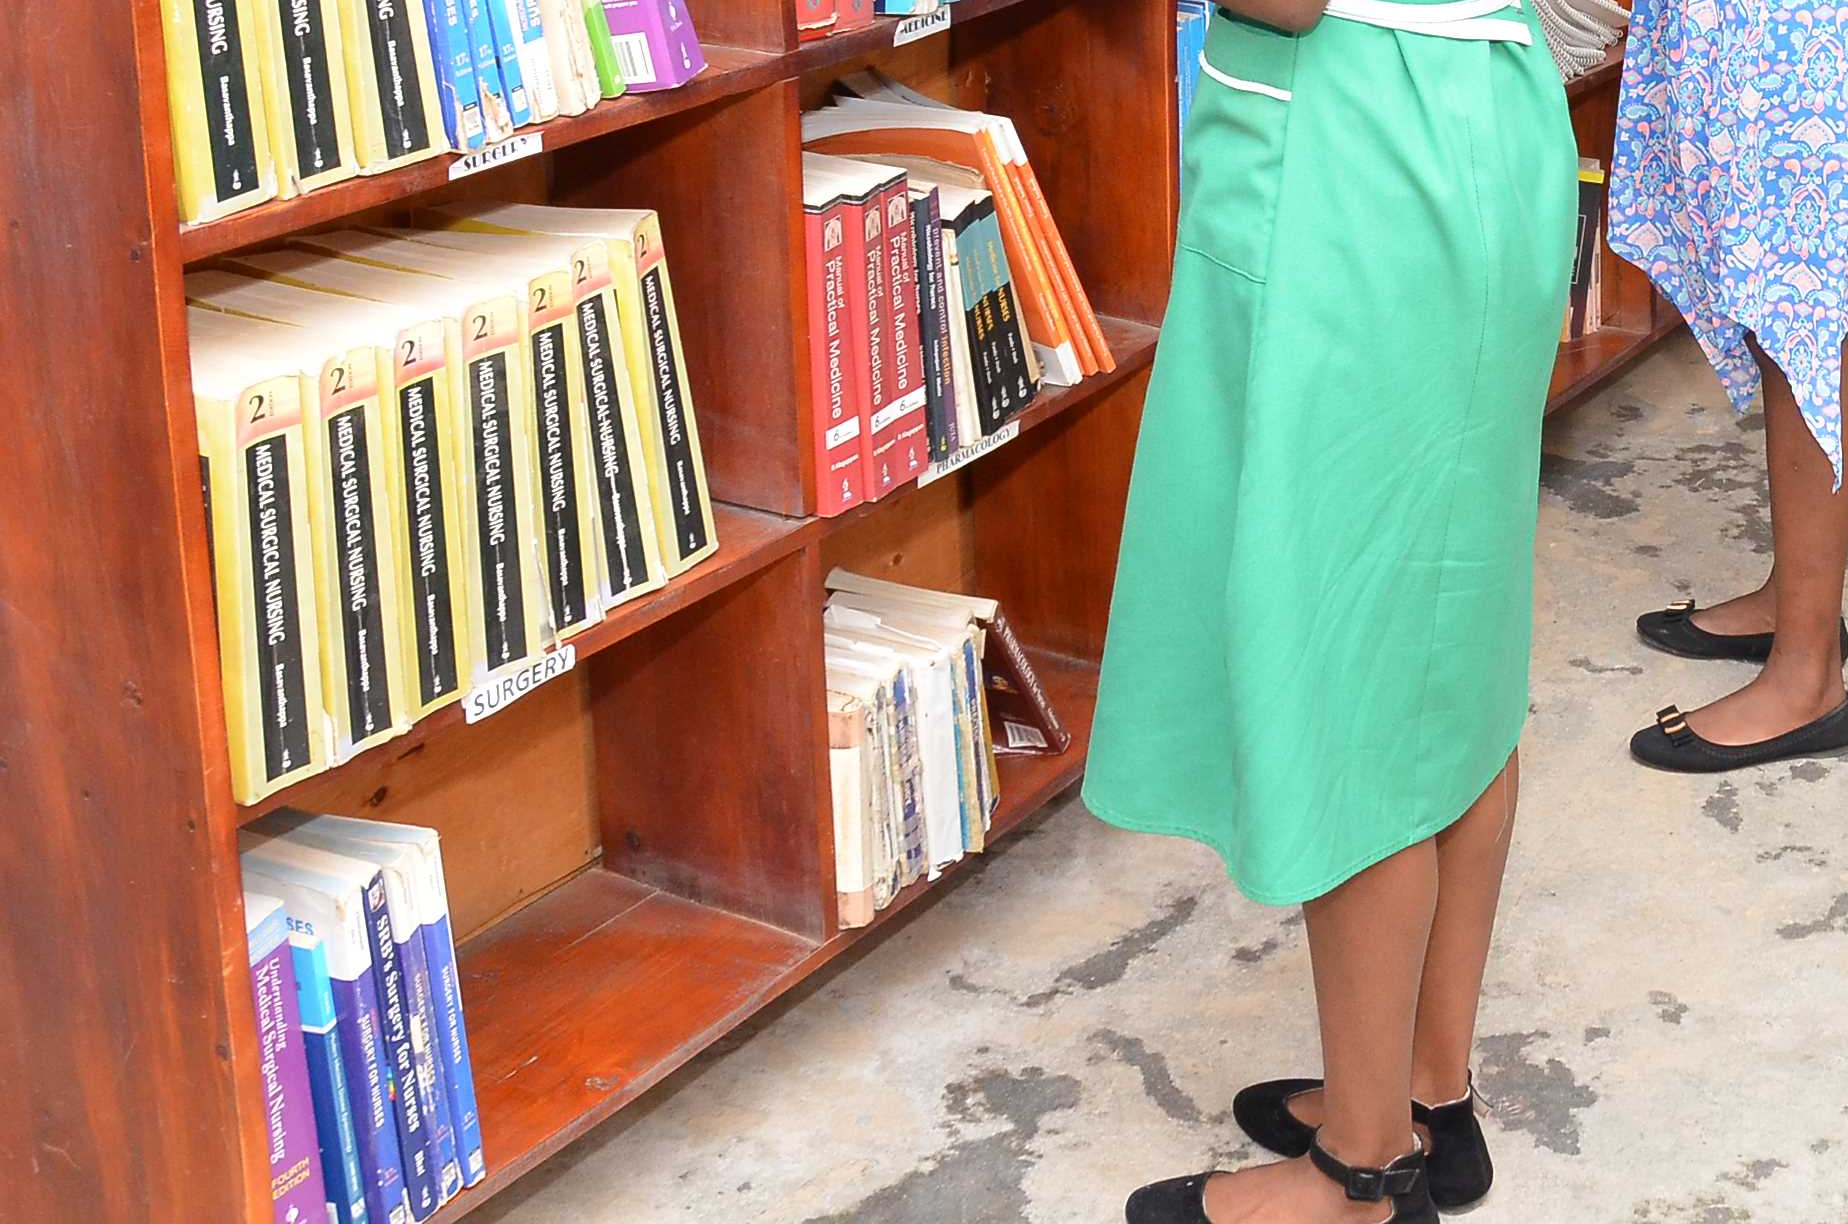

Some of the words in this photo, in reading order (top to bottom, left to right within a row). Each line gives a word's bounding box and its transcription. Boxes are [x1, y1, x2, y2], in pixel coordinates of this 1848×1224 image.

[575, 259, 587, 283] 2
[637, 234, 646, 258] 2
[873, 245, 883, 284] Manual
[888, 236, 904, 310] Practical
[898, 231, 908, 269] Manual
[533, 288, 547, 312] 2
[643, 274, 662, 328] MEDICAL
[823, 260, 838, 336] Practical
[833, 256, 844, 295] Manual
[836, 297, 845, 308] of
[864, 250, 879, 324] Practical
[875, 286, 883, 296] of
[901, 271, 909, 281] of
[401, 340, 416, 367] 2
[472, 315, 488, 341] 2
[579, 302, 601, 358] MEDICAL
[893, 313, 909, 389] Medicine
[331, 368, 346, 396] 2
[538, 332, 555, 389] MEDICAL
[588, 358, 610, 417] SURGICAL
[652, 329, 672, 388] SURGICAL
[827, 339, 843, 419] Medicine
[868, 328, 884, 404] Medicine
[250, 394, 265, 424] 2
[406, 388, 425, 446] MEDICAL
[478, 361, 496, 419] MEDICAL
[662, 389, 681, 444] NURSING
[336, 415, 355, 476] MEDICAL
[542, 390, 560, 452] SURGICAL
[597, 420, 619, 477] NURSING
[254, 444, 275, 507] MEDICAL
[411, 446, 430, 513] SURGICAL
[482, 421, 500, 484] SURGICAL
[936, 428, 1011, 474] PHARMACOLOGY
[547, 453, 565, 511] NURSING
[341, 477, 361, 546] SURGICAL
[486, 484, 504, 545] NURSING
[259, 508, 280, 578] SURGICAL
[417, 514, 435, 576] NURSING
[347, 547, 367, 610] NURSING
[264, 580, 284, 645] NURSING
[474, 650, 571, 716] SURGERY
[374, 914, 397, 970] SRB's
[254, 964, 274, 1029] Medical
[265, 957, 288, 1049] Understanding
[380, 972, 408, 1042] Surgery
[258, 1034, 280, 1097] Surgical
[358, 1014, 377, 1062] SURGERY
[394, 1043, 413, 1069] for
[366, 1063, 379, 1084] FOR
[398, 1070, 422, 1132] Nurses
[266, 1093, 288, 1163] Nursing
[368, 1085, 386, 1127] NURSES
[271, 1157, 309, 1188] FOURTH
[272, 1170, 310, 1200] EDITION
